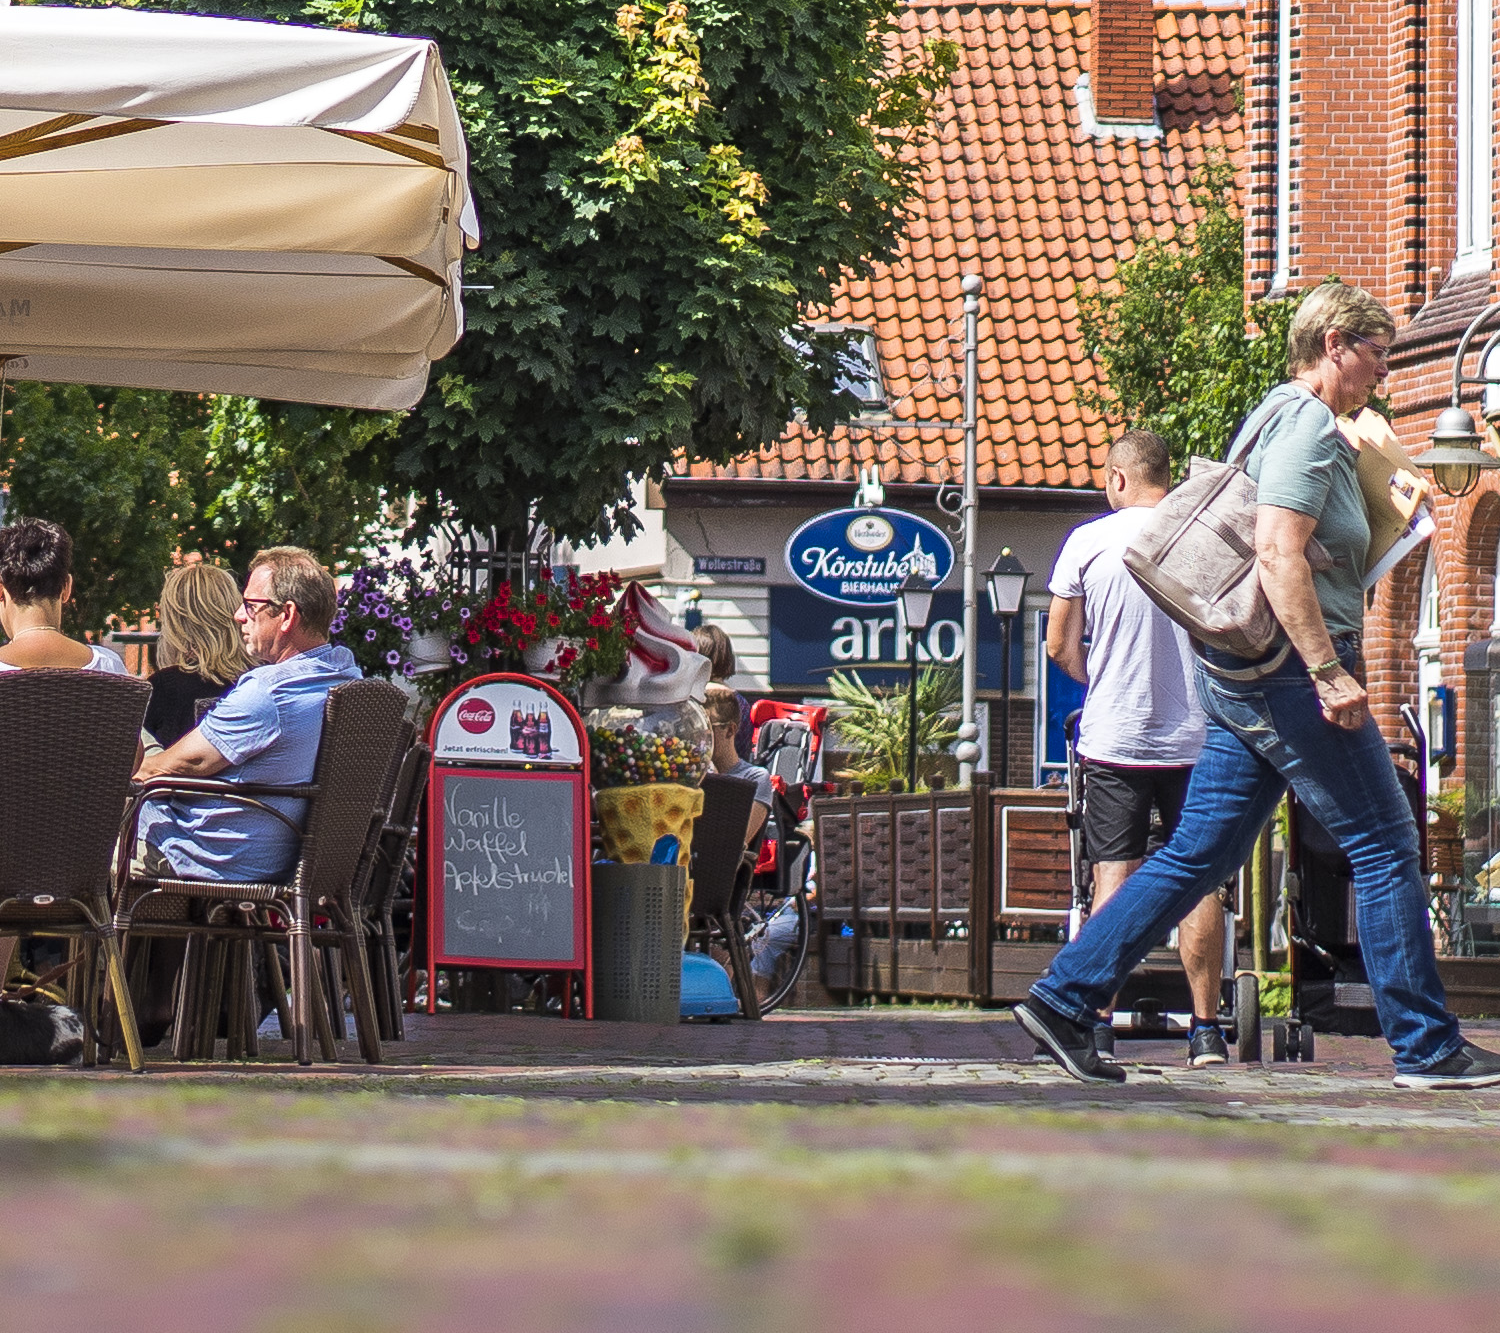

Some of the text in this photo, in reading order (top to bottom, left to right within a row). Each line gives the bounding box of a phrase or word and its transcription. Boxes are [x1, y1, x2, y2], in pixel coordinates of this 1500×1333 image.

[829, 597, 966, 663] arko
[444, 783, 525, 829] Vanille
[444, 828, 529, 864] Waffel
